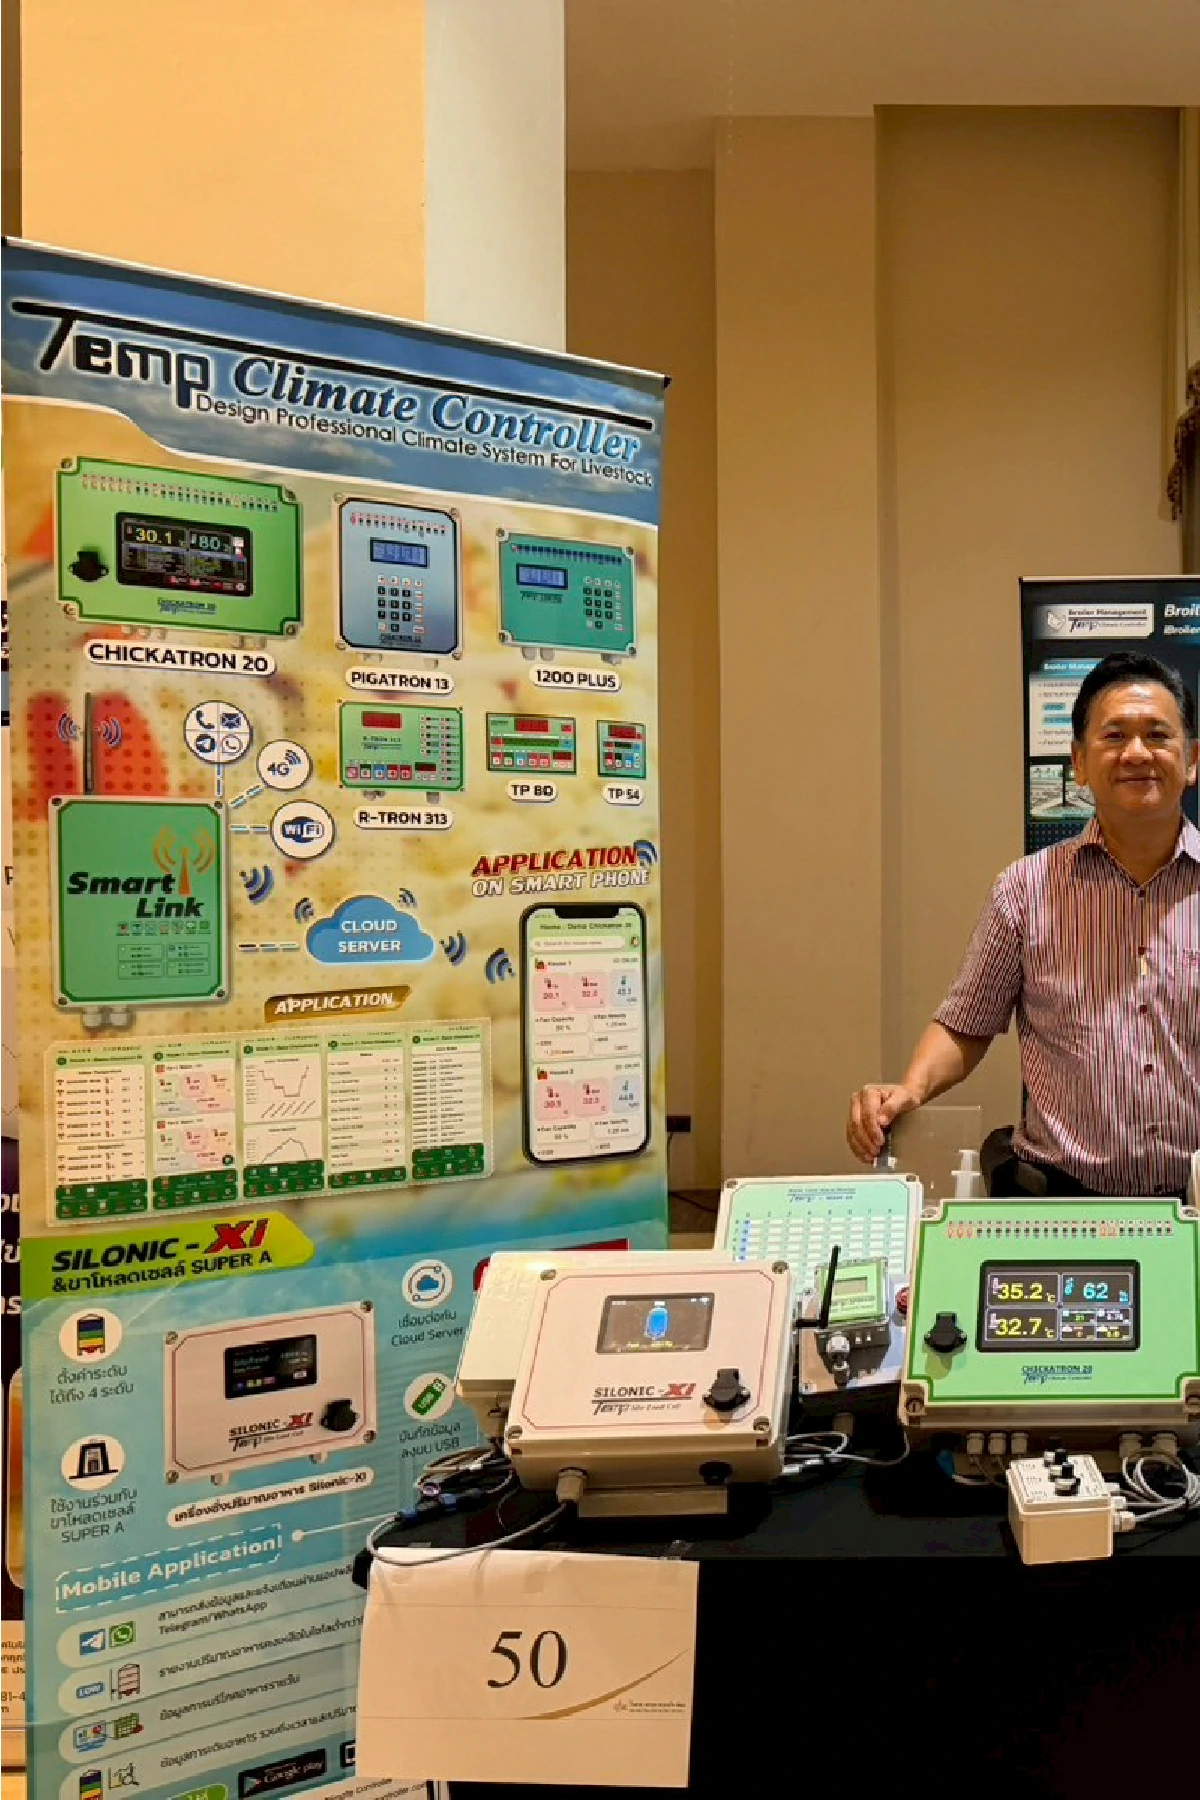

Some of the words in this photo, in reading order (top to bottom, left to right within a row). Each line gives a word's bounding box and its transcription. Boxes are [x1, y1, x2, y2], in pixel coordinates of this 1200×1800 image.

[234, 357, 418, 422] Climate
[432, 394, 640, 462] Controller
[196, 394, 270, 424] Design
[276, 408, 396, 443] Professional
[402, 429, 477, 456] Climate
[482, 442, 545, 467] System
[551, 453, 578, 471] For
[581, 458, 653, 487] Livestock
[89, 642, 236, 671] CHICKATRON
[242, 655, 268, 672] 20
[351, 671, 432, 689] PIGATRON
[434, 677, 450, 690] 13
[536, 669, 575, 684] 1200
[578, 673, 616, 688] PLUS
[267, 763, 290, 776] 4G
[510, 784, 531, 796] TP
[533, 784, 554, 797] 80
[607, 788, 624, 799] TP
[625, 788, 640, 801] 54
[359, 811, 421, 825] R-TRON
[424, 812, 448, 825] 313
[472, 846, 638, 877] APPLICATION
[66, 871, 176, 895] Smart
[472, 876, 503, 897] ON
[510, 873, 586, 895] SMART
[590, 867, 650, 888] PHONE
[136, 897, 205, 919] Link
[341, 920, 398, 933] CLOUD
[338, 939, 401, 954] SERVER
[275, 992, 394, 1015] APPLICATION
[191, 1254, 253, 1275] SUPER
[258, 1250, 273, 1263] A
[998, 1282, 1043, 1300] 35.2
[1083, 1282, 1109, 1300] 62
[995, 1316, 1043, 1336] 32.7
[391, 1332, 425, 1347] Cloud
[427, 1326, 464, 1341] Server
[87, 1388, 98, 1399] 4
[436, 1437, 461, 1452] USB
[61, 1524, 110, 1543] SUPER
[114, 1520, 125, 1533] A
[62, 1570, 141, 1600] Mobile
[148, 1537, 279, 1581] Application
[487, 1630, 569, 1689] 50
